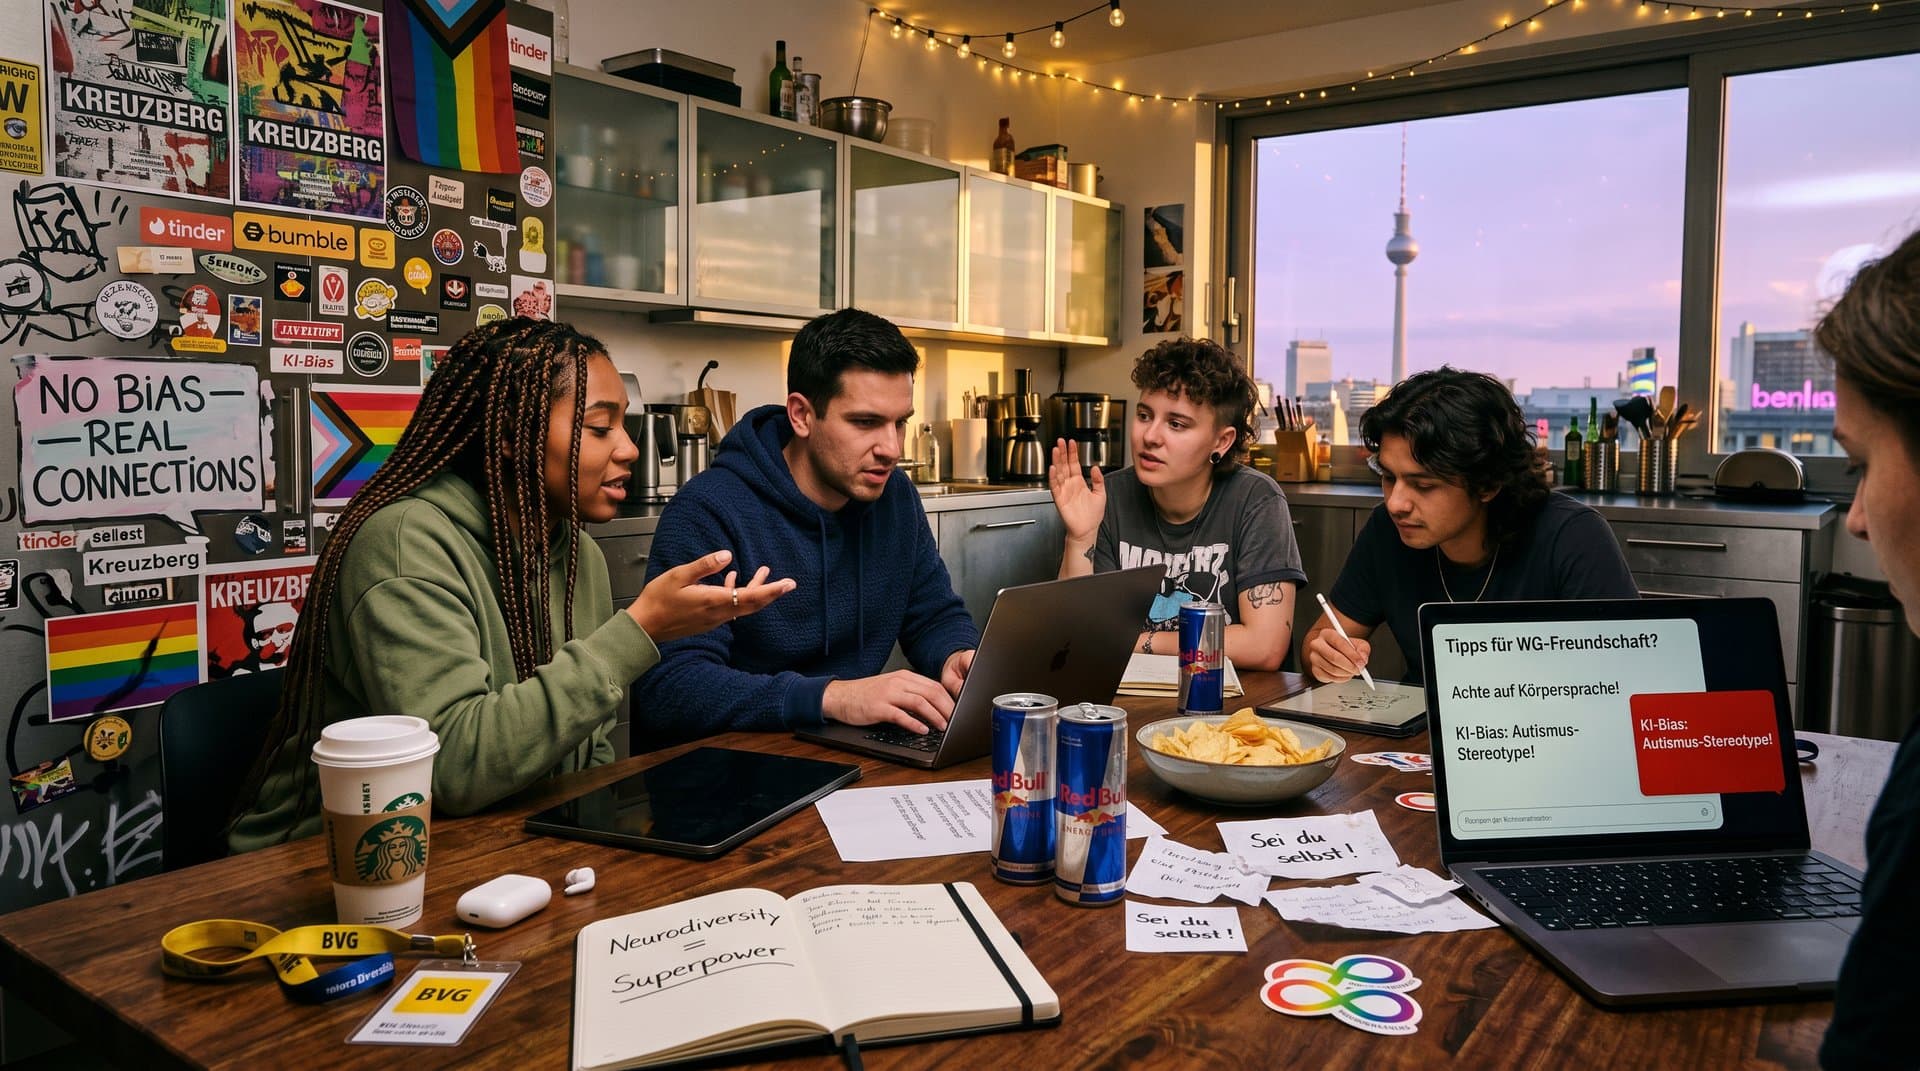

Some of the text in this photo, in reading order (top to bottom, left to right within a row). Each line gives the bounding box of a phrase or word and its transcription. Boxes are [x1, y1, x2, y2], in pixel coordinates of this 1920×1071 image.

[510, 37, 548, 62] tinder
[66, 82, 223, 133] KREUZBERG
[247, 118, 382, 162] KREUZBERG
[168, 218, 225, 241] tinder
[268, 226, 348, 251] bumble
[283, 354, 334, 368] KI-Bias
[40, 374, 99, 414] NO
[89, 551, 200, 575] Kreuzberg
[1445, 633, 1658, 656] Tipps für WG-Freundschaft?
[1195, 650, 1220, 663] Bull
[1452, 681, 1620, 701] Achte auf Körpersprache!
[1456, 724, 1579, 740] KI-Bias: Autismus-
[1640, 718, 1688, 731] KI-Bias:
[1643, 733, 1773, 750] Autismus-Stereotype!
[1458, 745, 1535, 762] Stereotype!
[1010, 771, 1045, 791] Bull
[1060, 783, 1096, 807] Red
[1250, 830, 1327, 849] Sei du
[1136, 913, 1210, 926] Sei du
[322, 931, 359, 949] BVG
[610, 907, 782, 955] Neurodiversity
[612, 945, 786, 994] Superpower
[415, 988, 472, 1002] BVG
